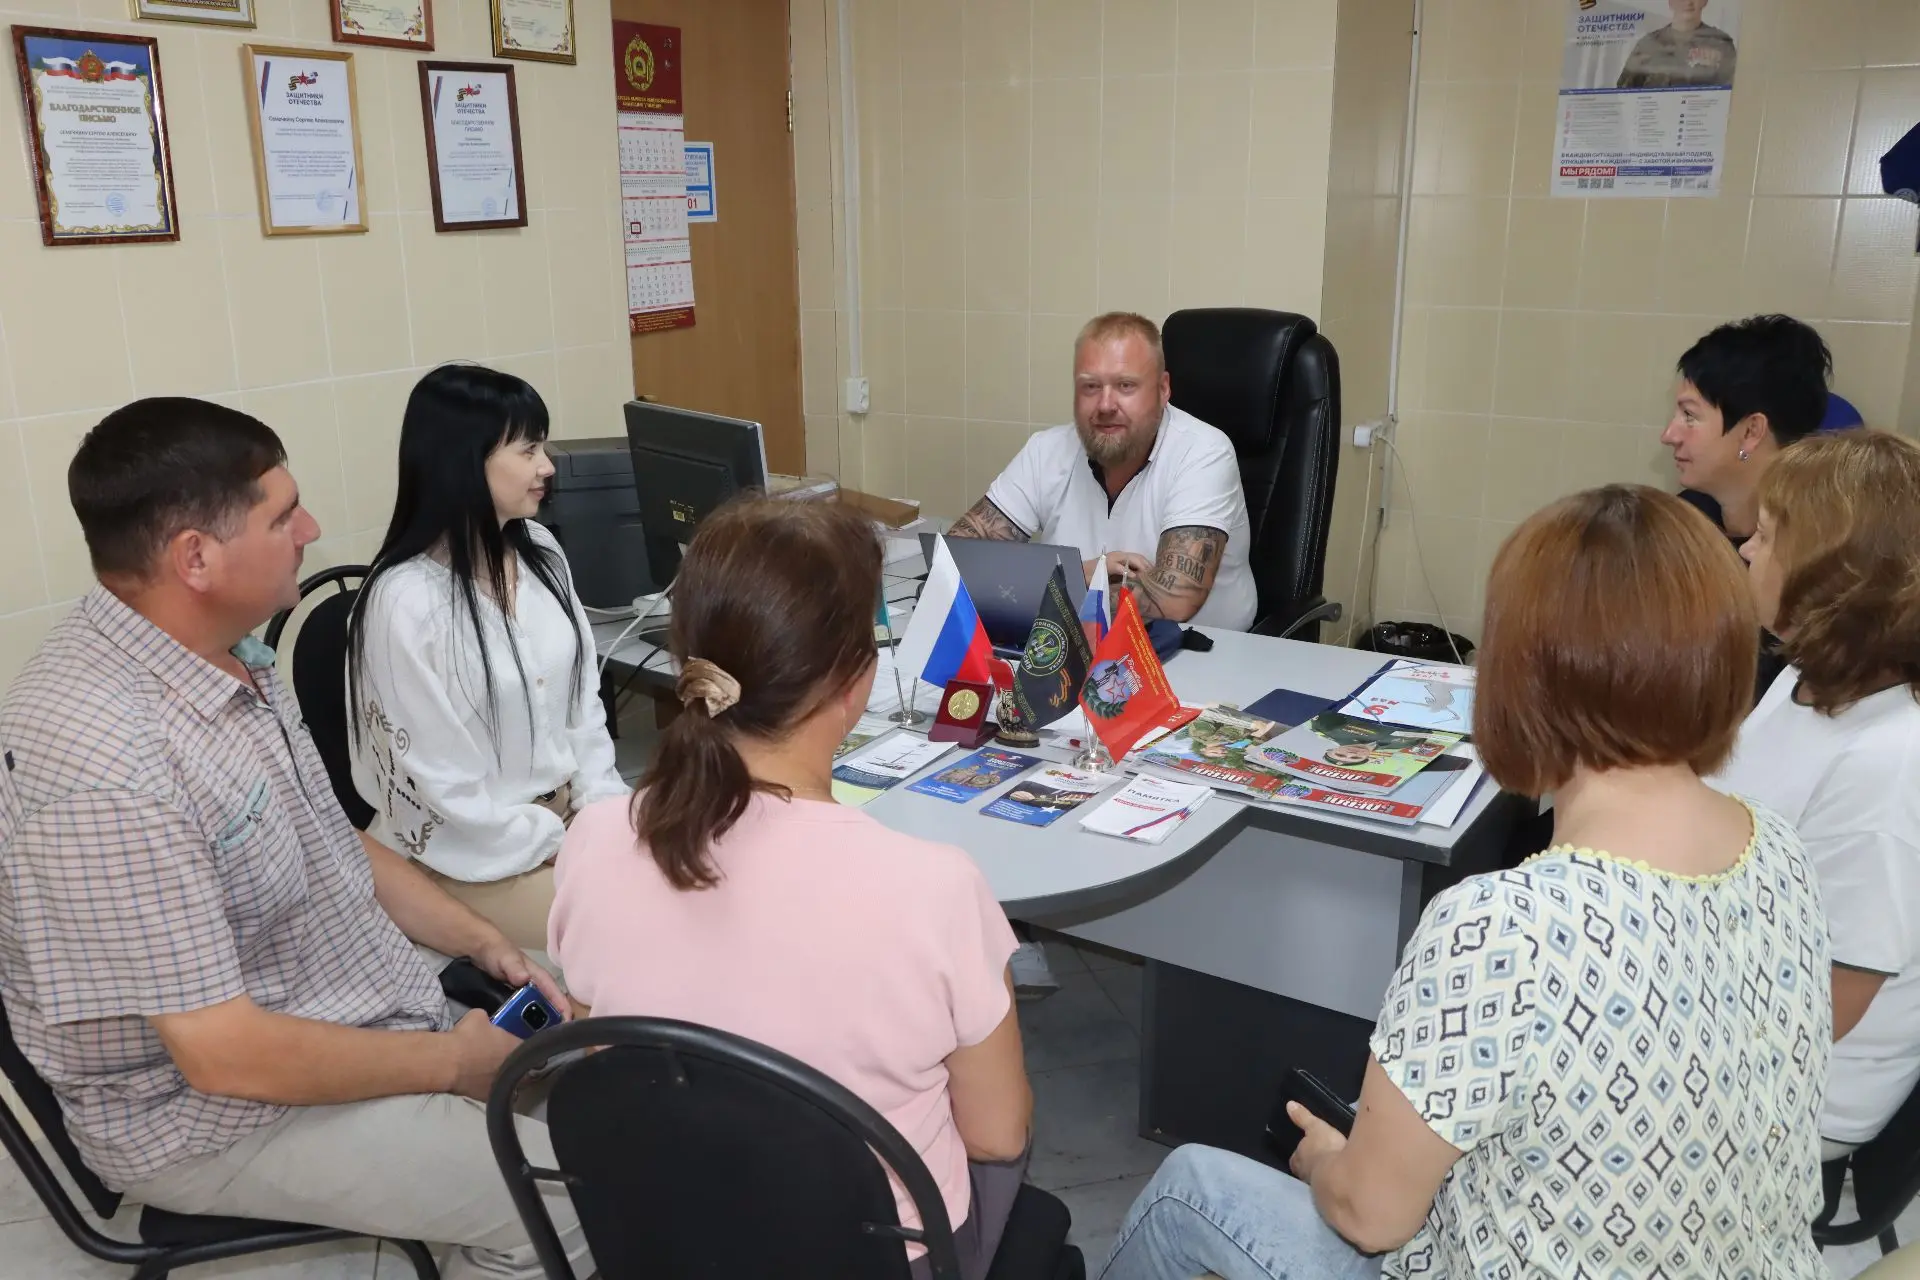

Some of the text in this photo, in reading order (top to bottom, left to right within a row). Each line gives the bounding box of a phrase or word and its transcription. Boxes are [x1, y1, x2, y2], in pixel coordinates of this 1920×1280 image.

[1578, 12, 1645, 24] ЗАЩИТНИКИ
[1577, 23, 1635, 33] ОТЕЧЕСТВА
[49, 103, 142, 115] БЛАГОДАРСТВЕННОЕ
[79, 114, 116, 123] ПИСЬМО
[1562, 167, 1578, 176] МЫ
[1578, 167, 1615, 176] РЯДОМ!
[687, 197, 698, 209] 01
[1127, 788, 1180, 803] ПАМЯТКА
